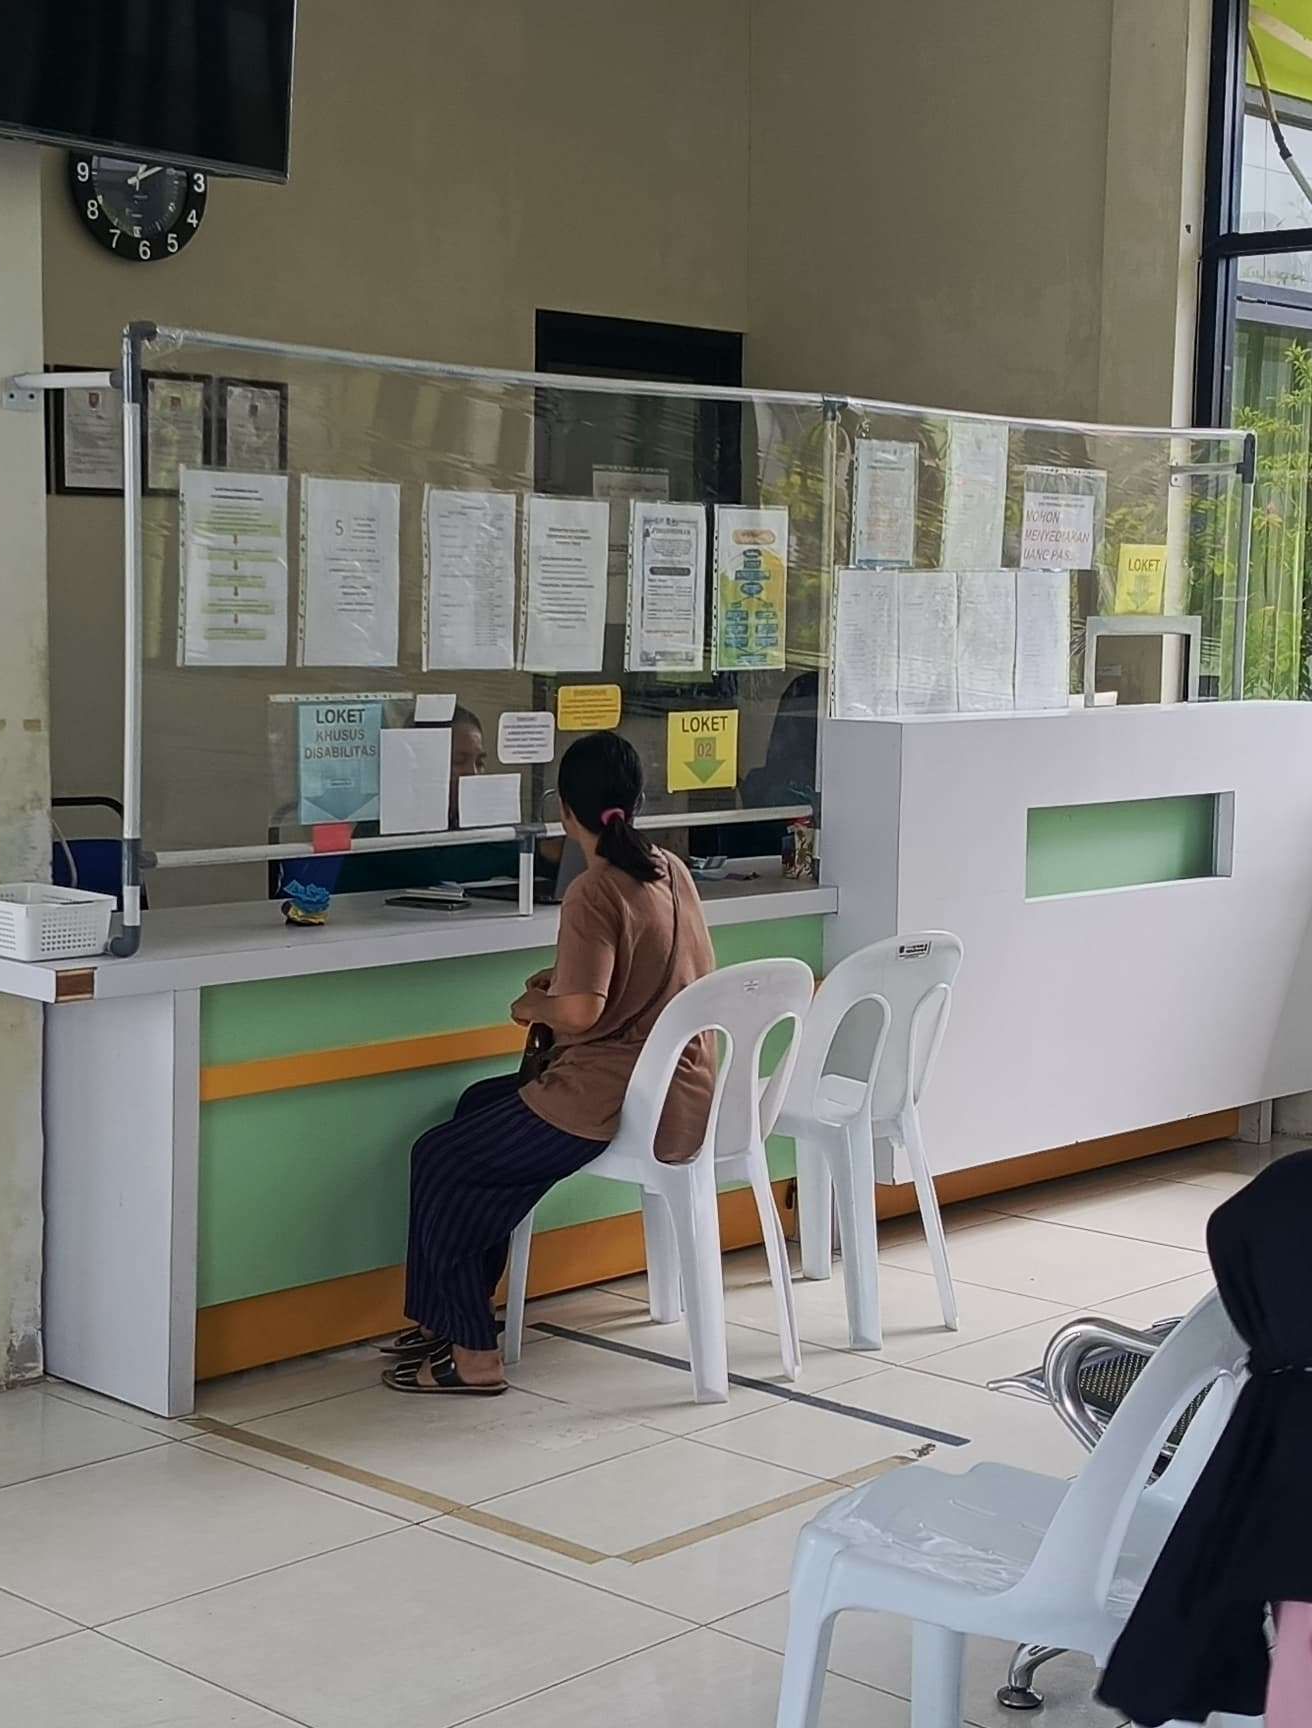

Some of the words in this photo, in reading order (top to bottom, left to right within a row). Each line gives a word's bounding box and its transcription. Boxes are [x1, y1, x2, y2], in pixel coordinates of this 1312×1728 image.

[77, 162, 89, 182] 9
[193, 173, 205, 193] 3
[87, 199, 99, 219] 8
[186, 209, 198, 228] 4
[109, 229, 120, 248] 7
[167, 233, 178, 252] 5
[139, 240, 151, 260] 6
[1128, 558, 1160, 572] LOKET
[316, 708, 365, 724] LOKET
[681, 716, 728, 733] LOKET
[316, 728, 365, 742] KHUSUS
[304, 744, 377, 760] DISABILITAS
[697, 743, 712, 757] 02
